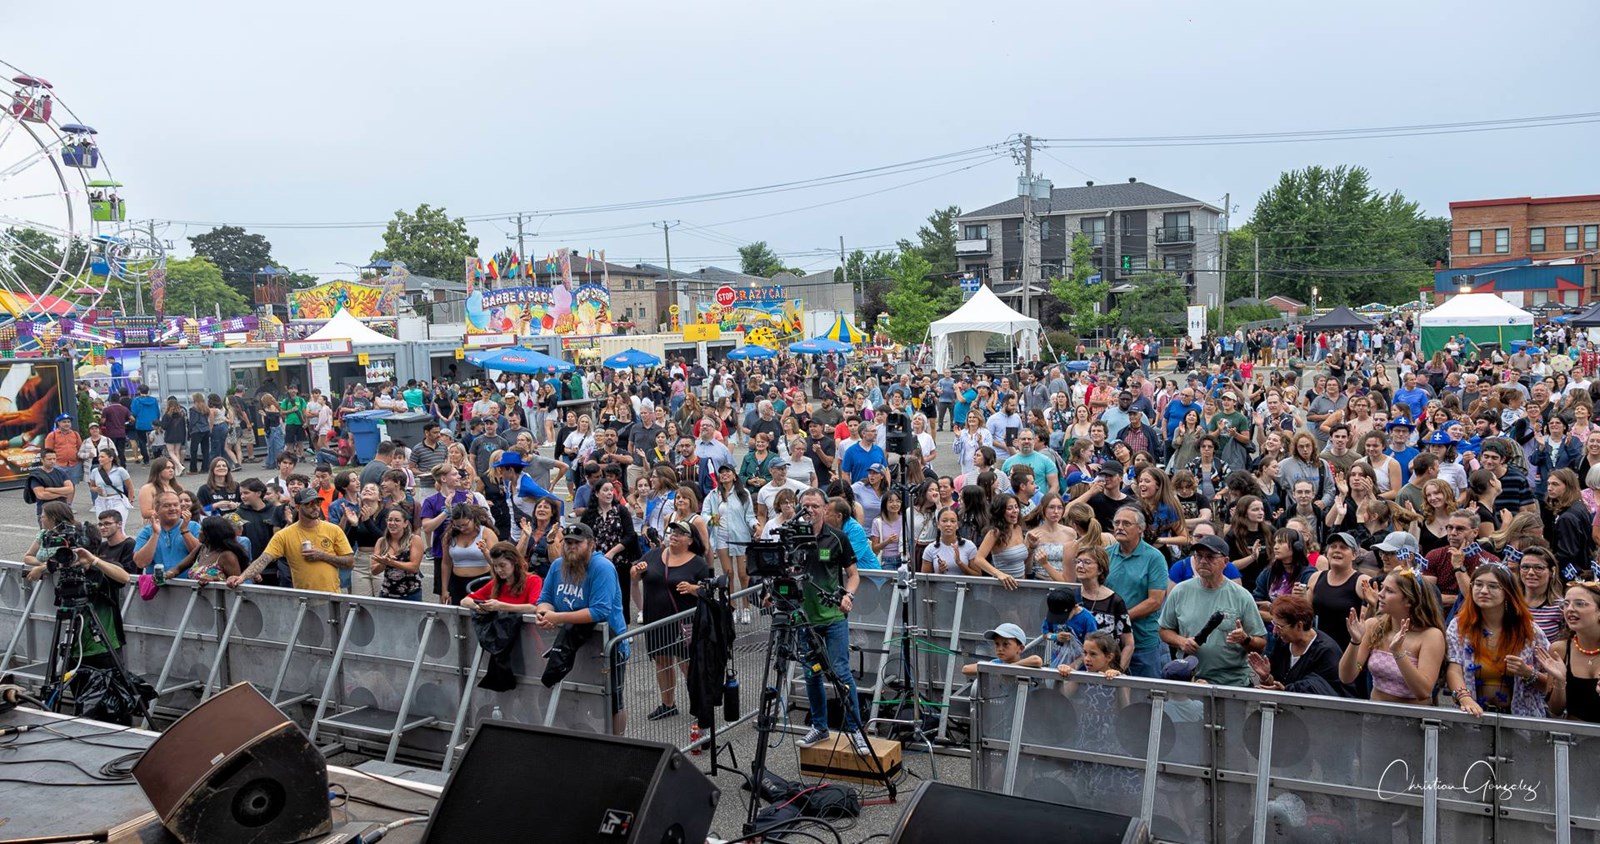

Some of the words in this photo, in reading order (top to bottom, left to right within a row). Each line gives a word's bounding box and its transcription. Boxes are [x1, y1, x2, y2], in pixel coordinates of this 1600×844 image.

[482, 292, 516, 309] BARBE
[528, 290, 556, 306] PAPA
[576, 287, 591, 305] POP
[718, 292, 734, 302] STOP
[734, 288, 767, 300] CRAZY
[556, 583, 584, 601] PUMA
